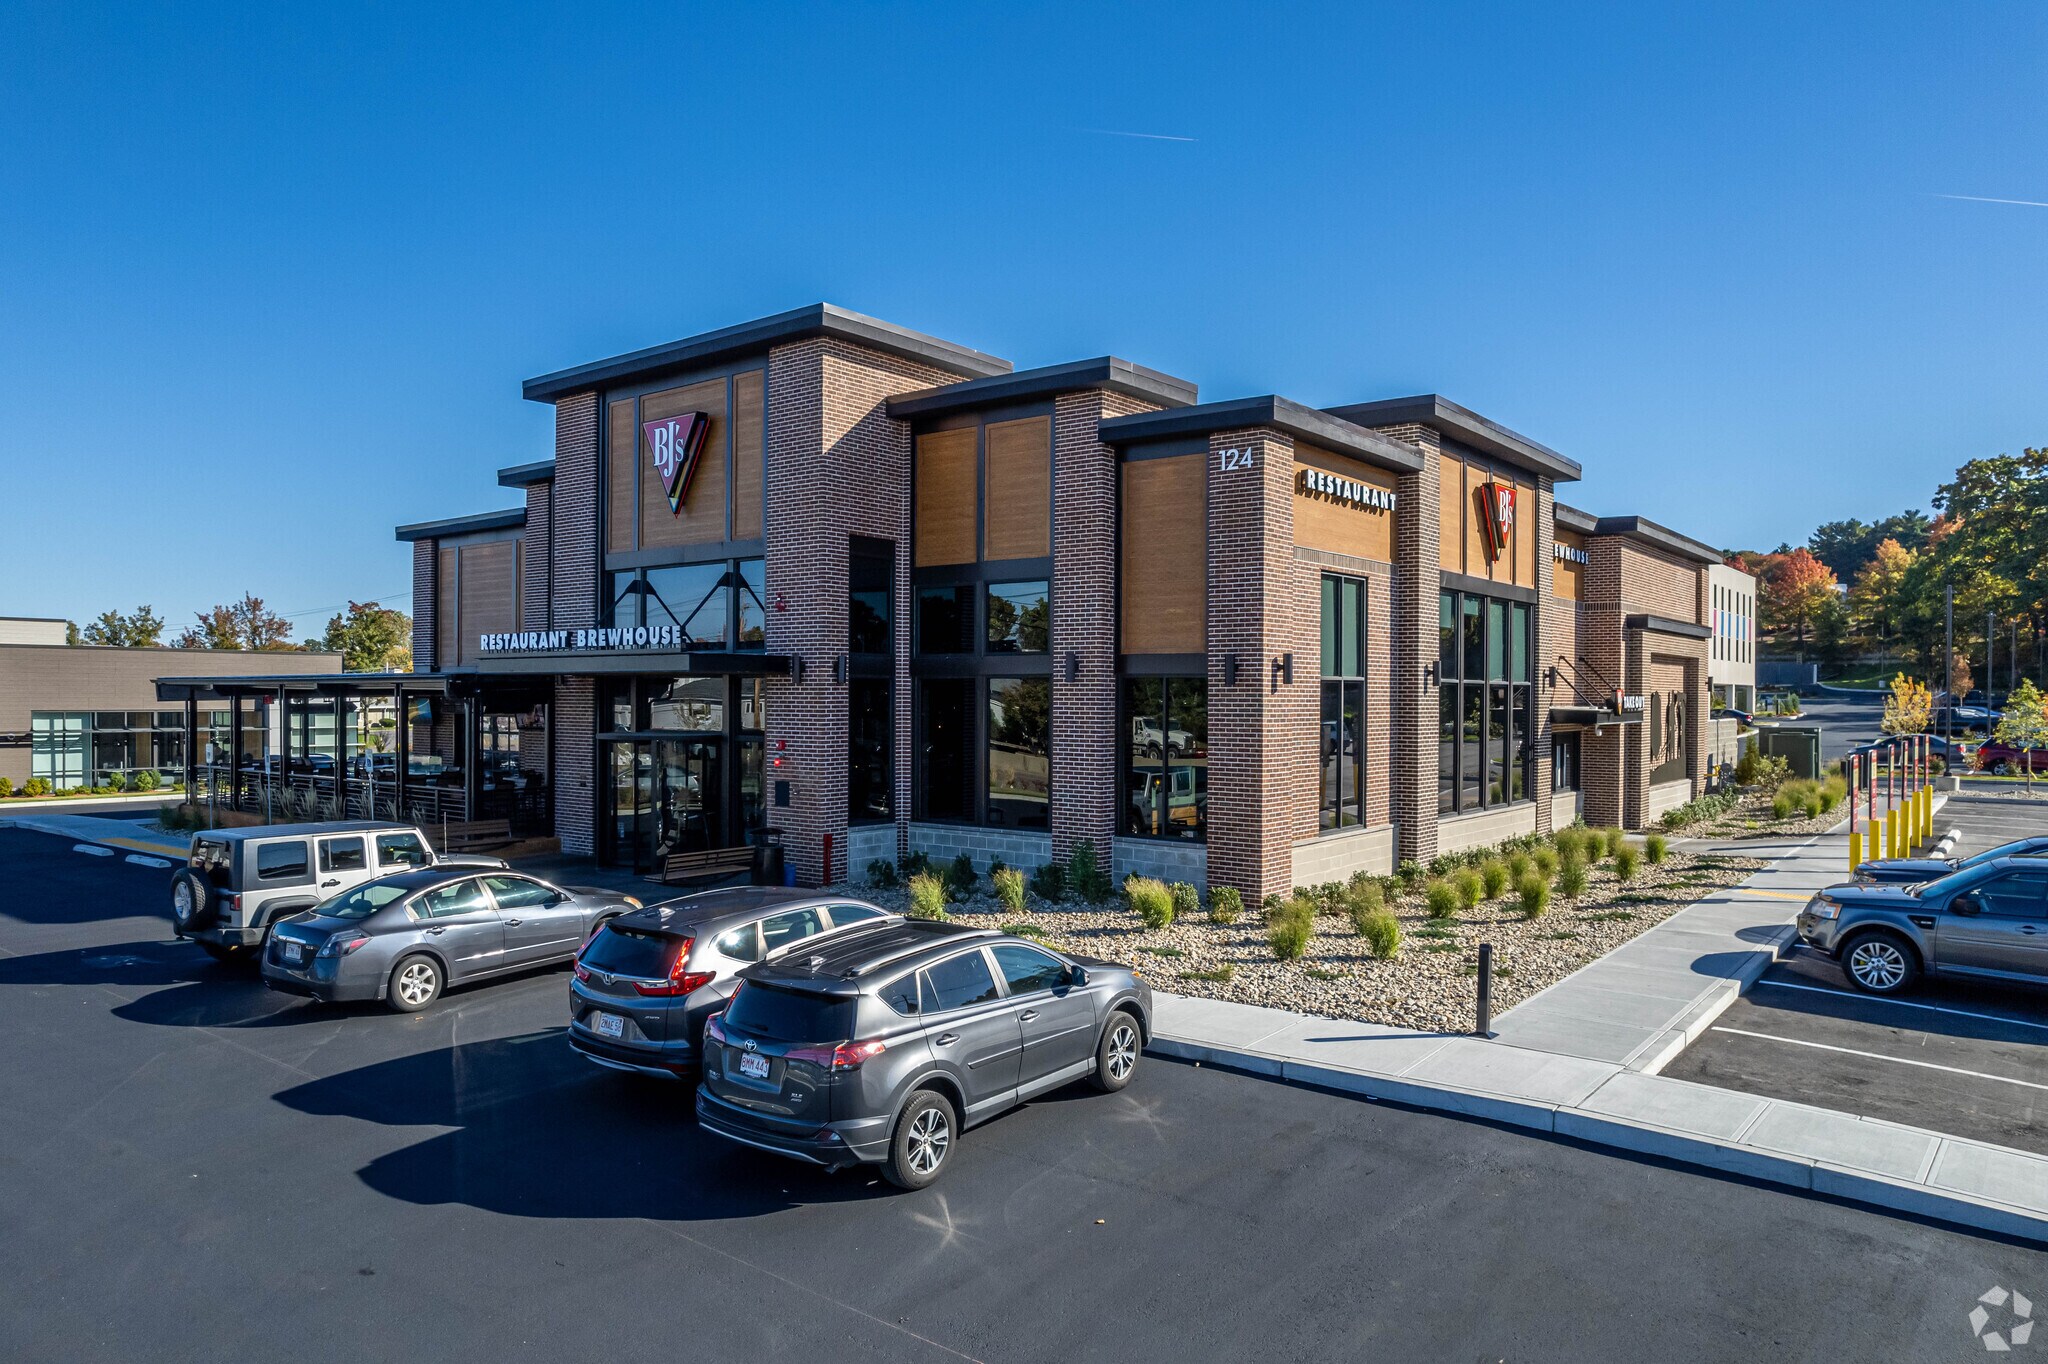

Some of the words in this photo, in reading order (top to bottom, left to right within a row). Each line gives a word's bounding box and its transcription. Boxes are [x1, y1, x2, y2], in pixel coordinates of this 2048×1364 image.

[653, 421, 684, 477] BJ's
[1218, 447, 1253, 471] 124
[1306, 468, 1396, 511] RESTAURANT
[1499, 490, 1513, 533] BJ's
[480, 630, 568, 650] RESTAURANT
[577, 625, 681, 647] BREWHOUSE
